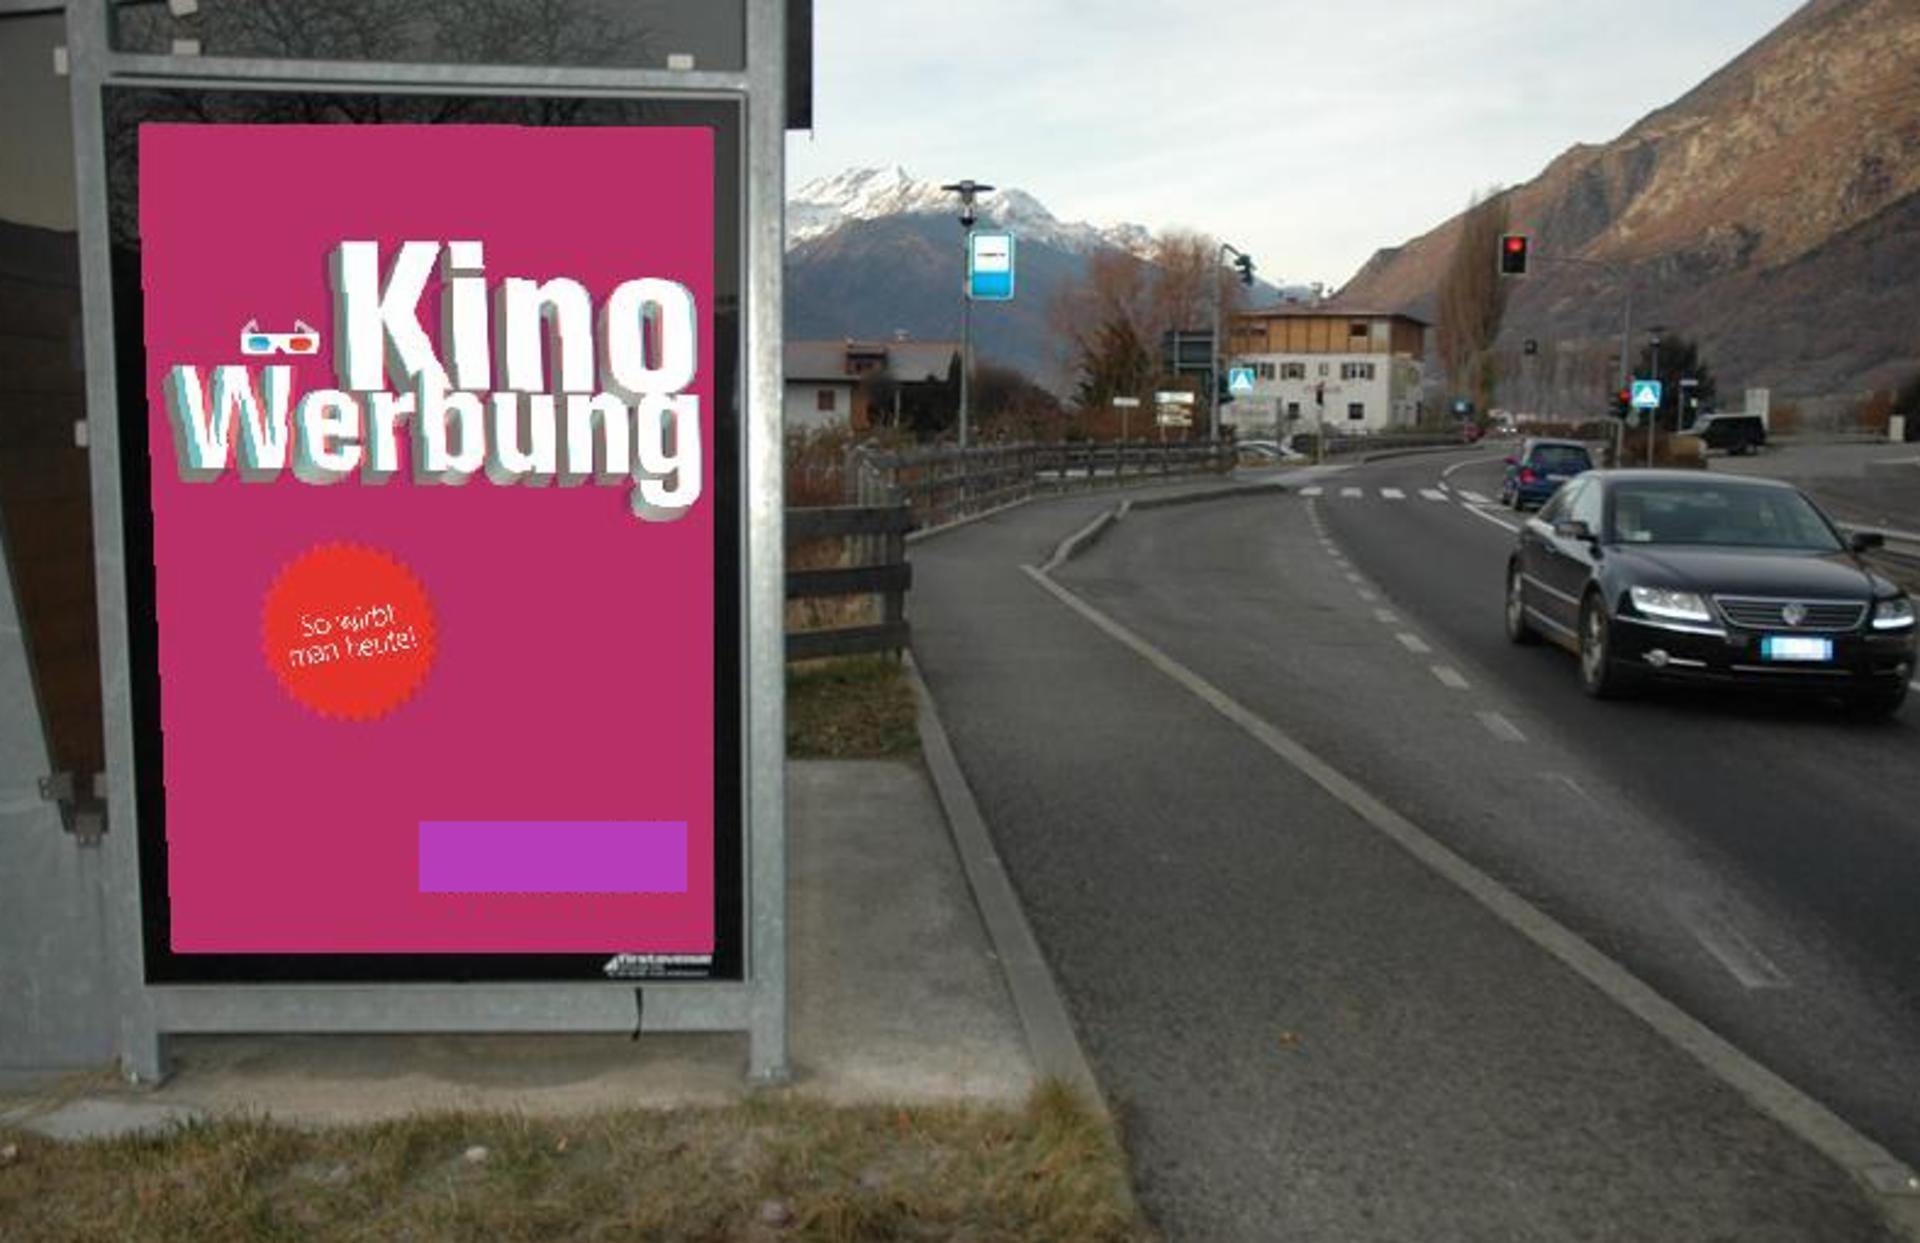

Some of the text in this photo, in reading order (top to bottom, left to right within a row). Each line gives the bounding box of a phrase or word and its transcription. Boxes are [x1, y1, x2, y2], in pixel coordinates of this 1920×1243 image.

[331, 240, 698, 393] Kino
[164, 364, 702, 520] Werbung
[289, 643, 340, 667] man
[300, 613, 332, 637] So
